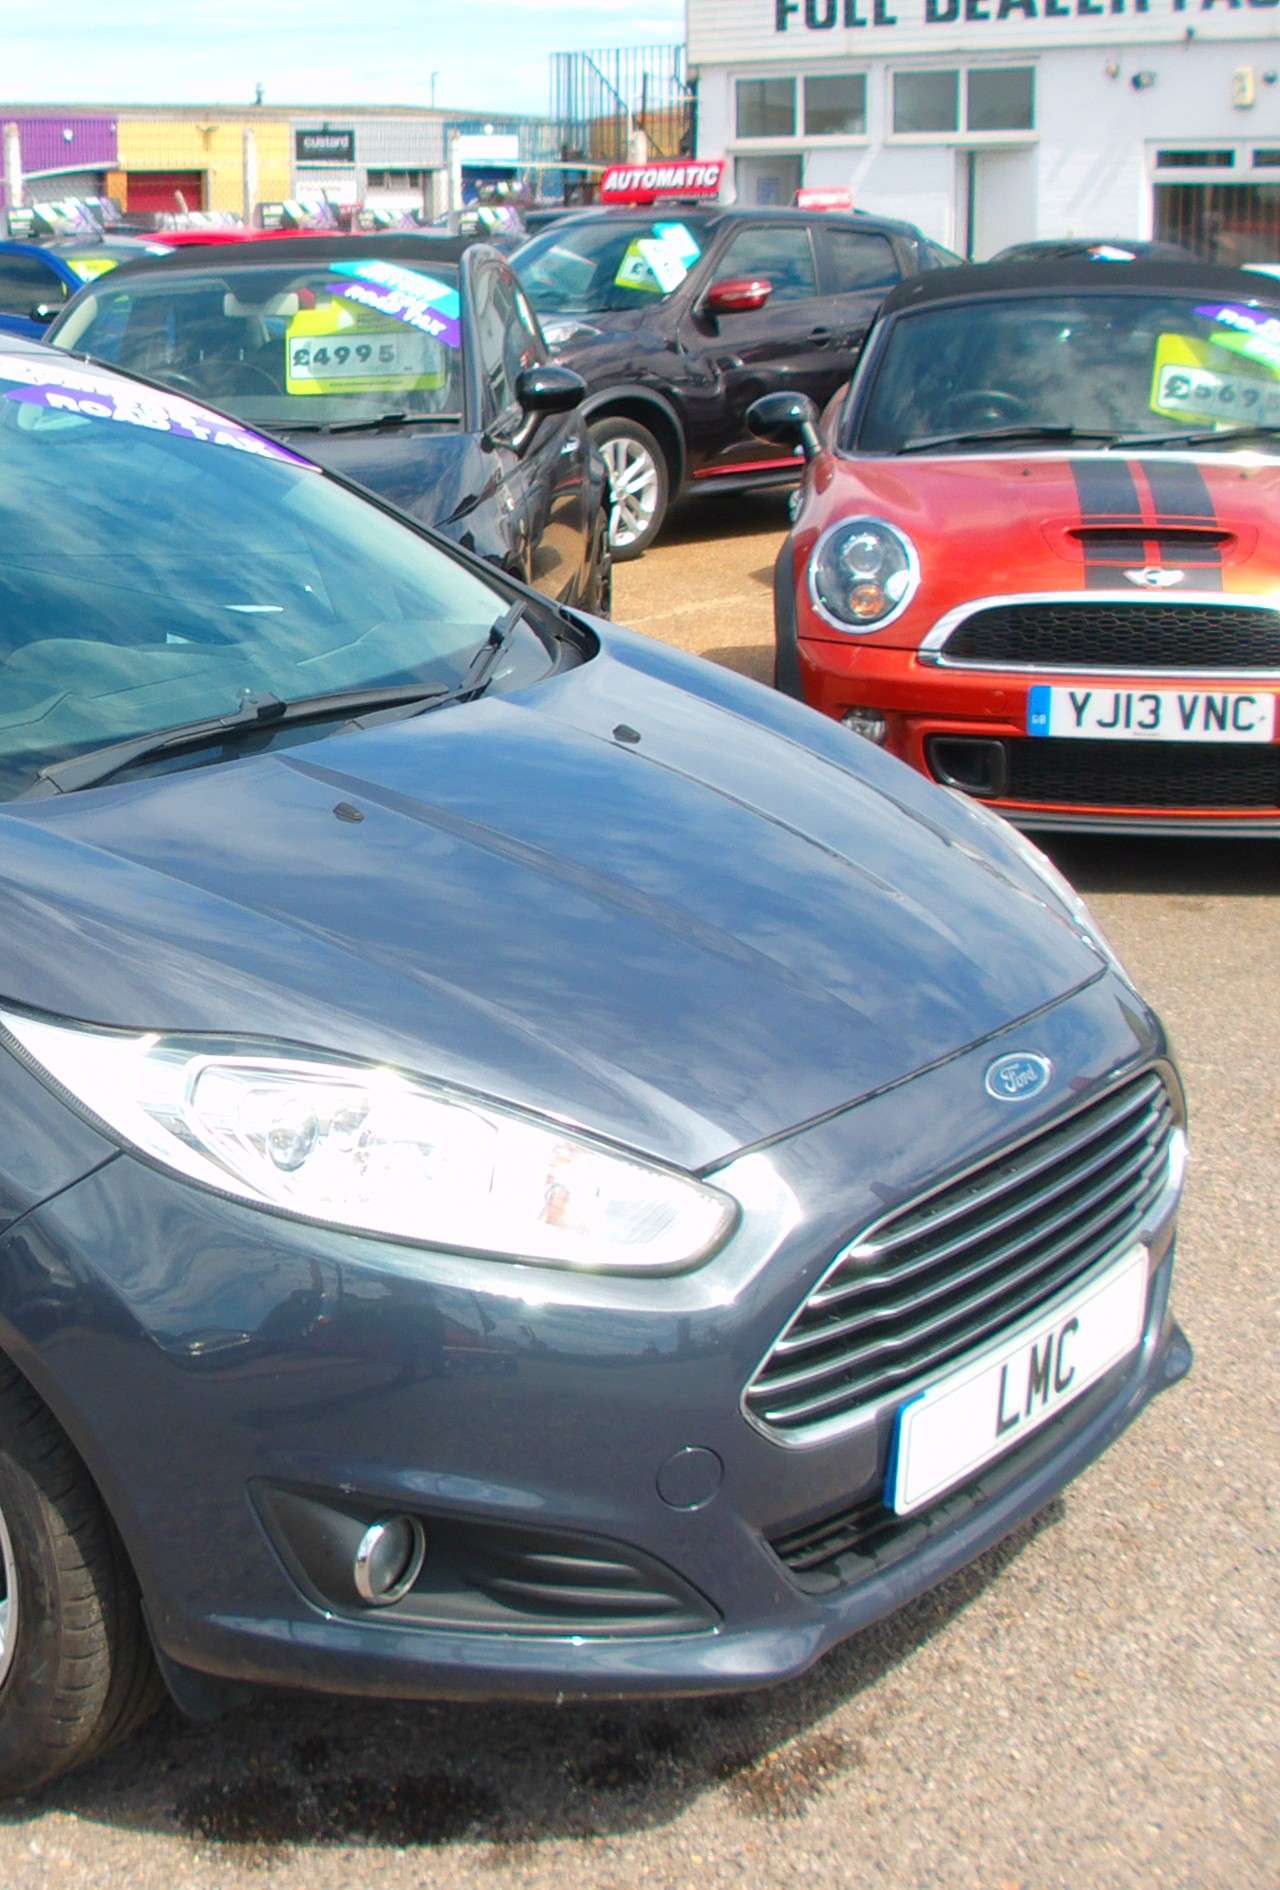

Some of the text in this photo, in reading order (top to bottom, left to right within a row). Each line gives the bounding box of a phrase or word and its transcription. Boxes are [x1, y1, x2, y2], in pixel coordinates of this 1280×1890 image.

[776, 0, 897, 31] FULL
[924, 0, 1149, 23] DEA
[605, 163, 720, 191] AUTOMATIC
[293, 344, 396, 366] £4995
[1068, 691, 1257, 732] YJ13 VNC
[999, 1063, 1038, 1093] Ford
[995, 1316, 1079, 1438] LMC
